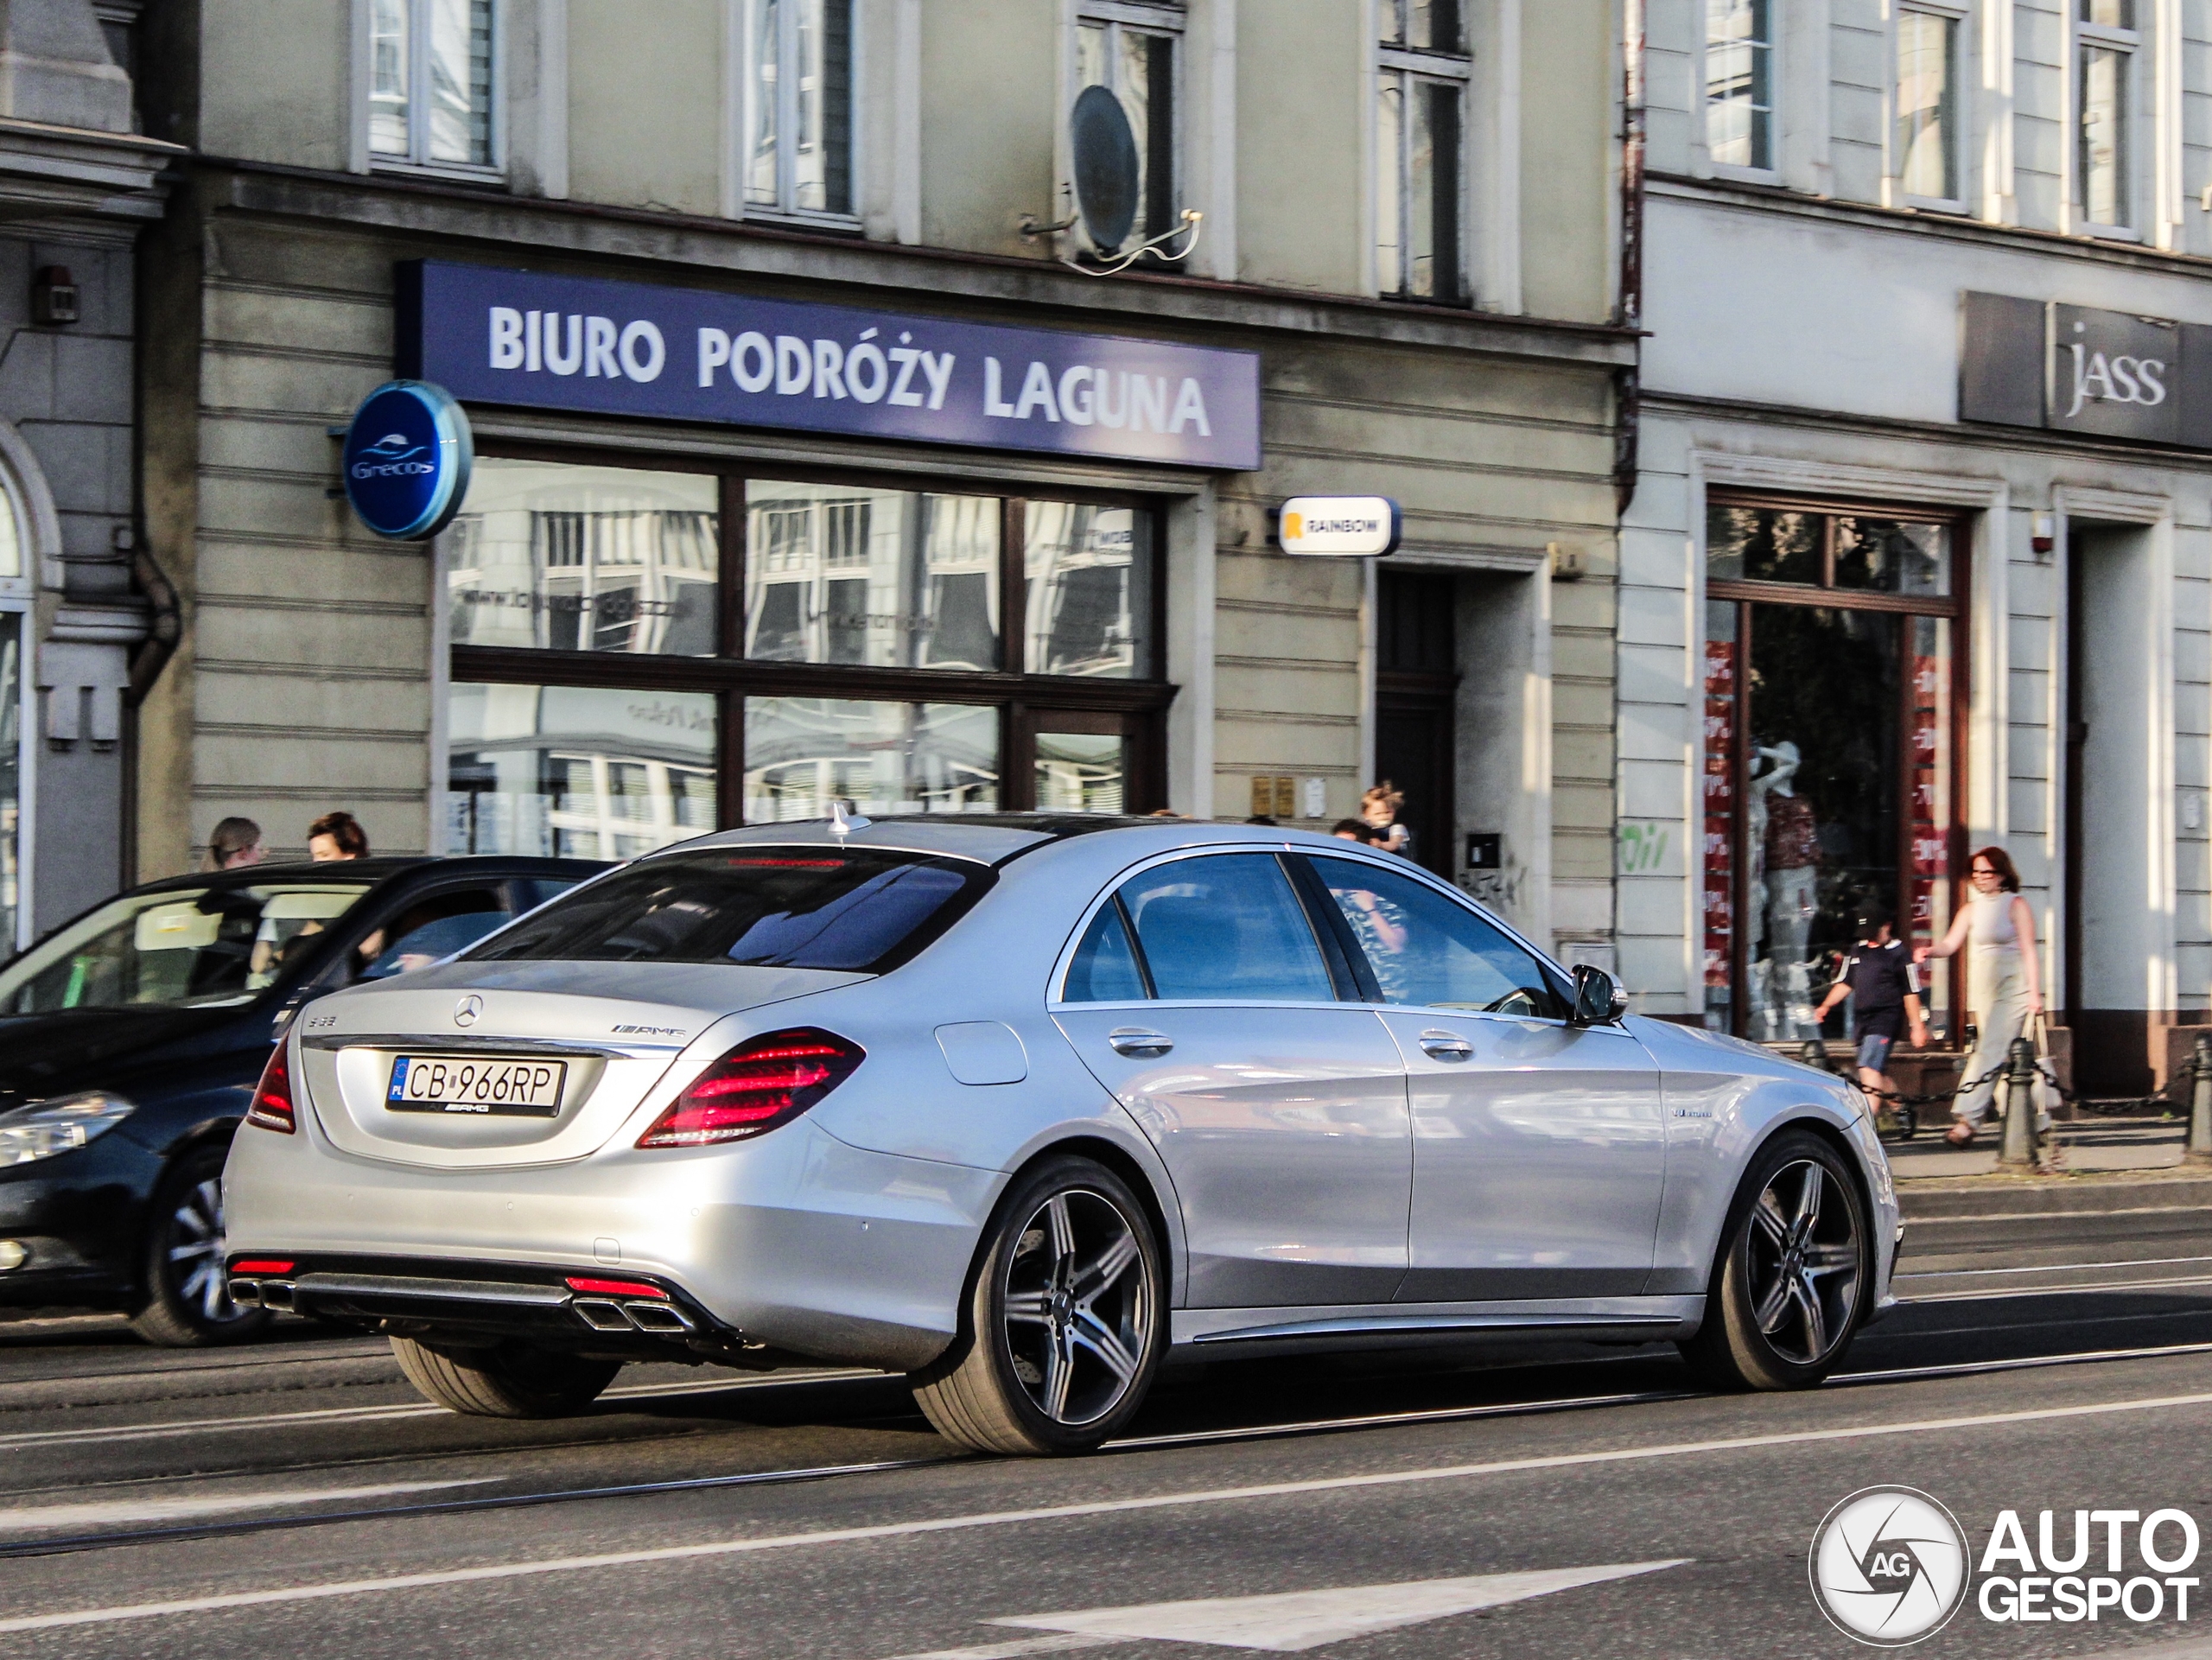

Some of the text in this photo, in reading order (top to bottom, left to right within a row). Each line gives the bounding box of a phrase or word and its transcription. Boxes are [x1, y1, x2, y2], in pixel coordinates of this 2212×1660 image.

[489, 306, 1211, 436] BIURO PODRÓŻY LAGUNA
[352, 461, 435, 479] Grecos
[391, 1085, 403, 1096] PL
[410, 1064, 551, 1103] CB 966RP
[459, 1104, 490, 1113] AMG
